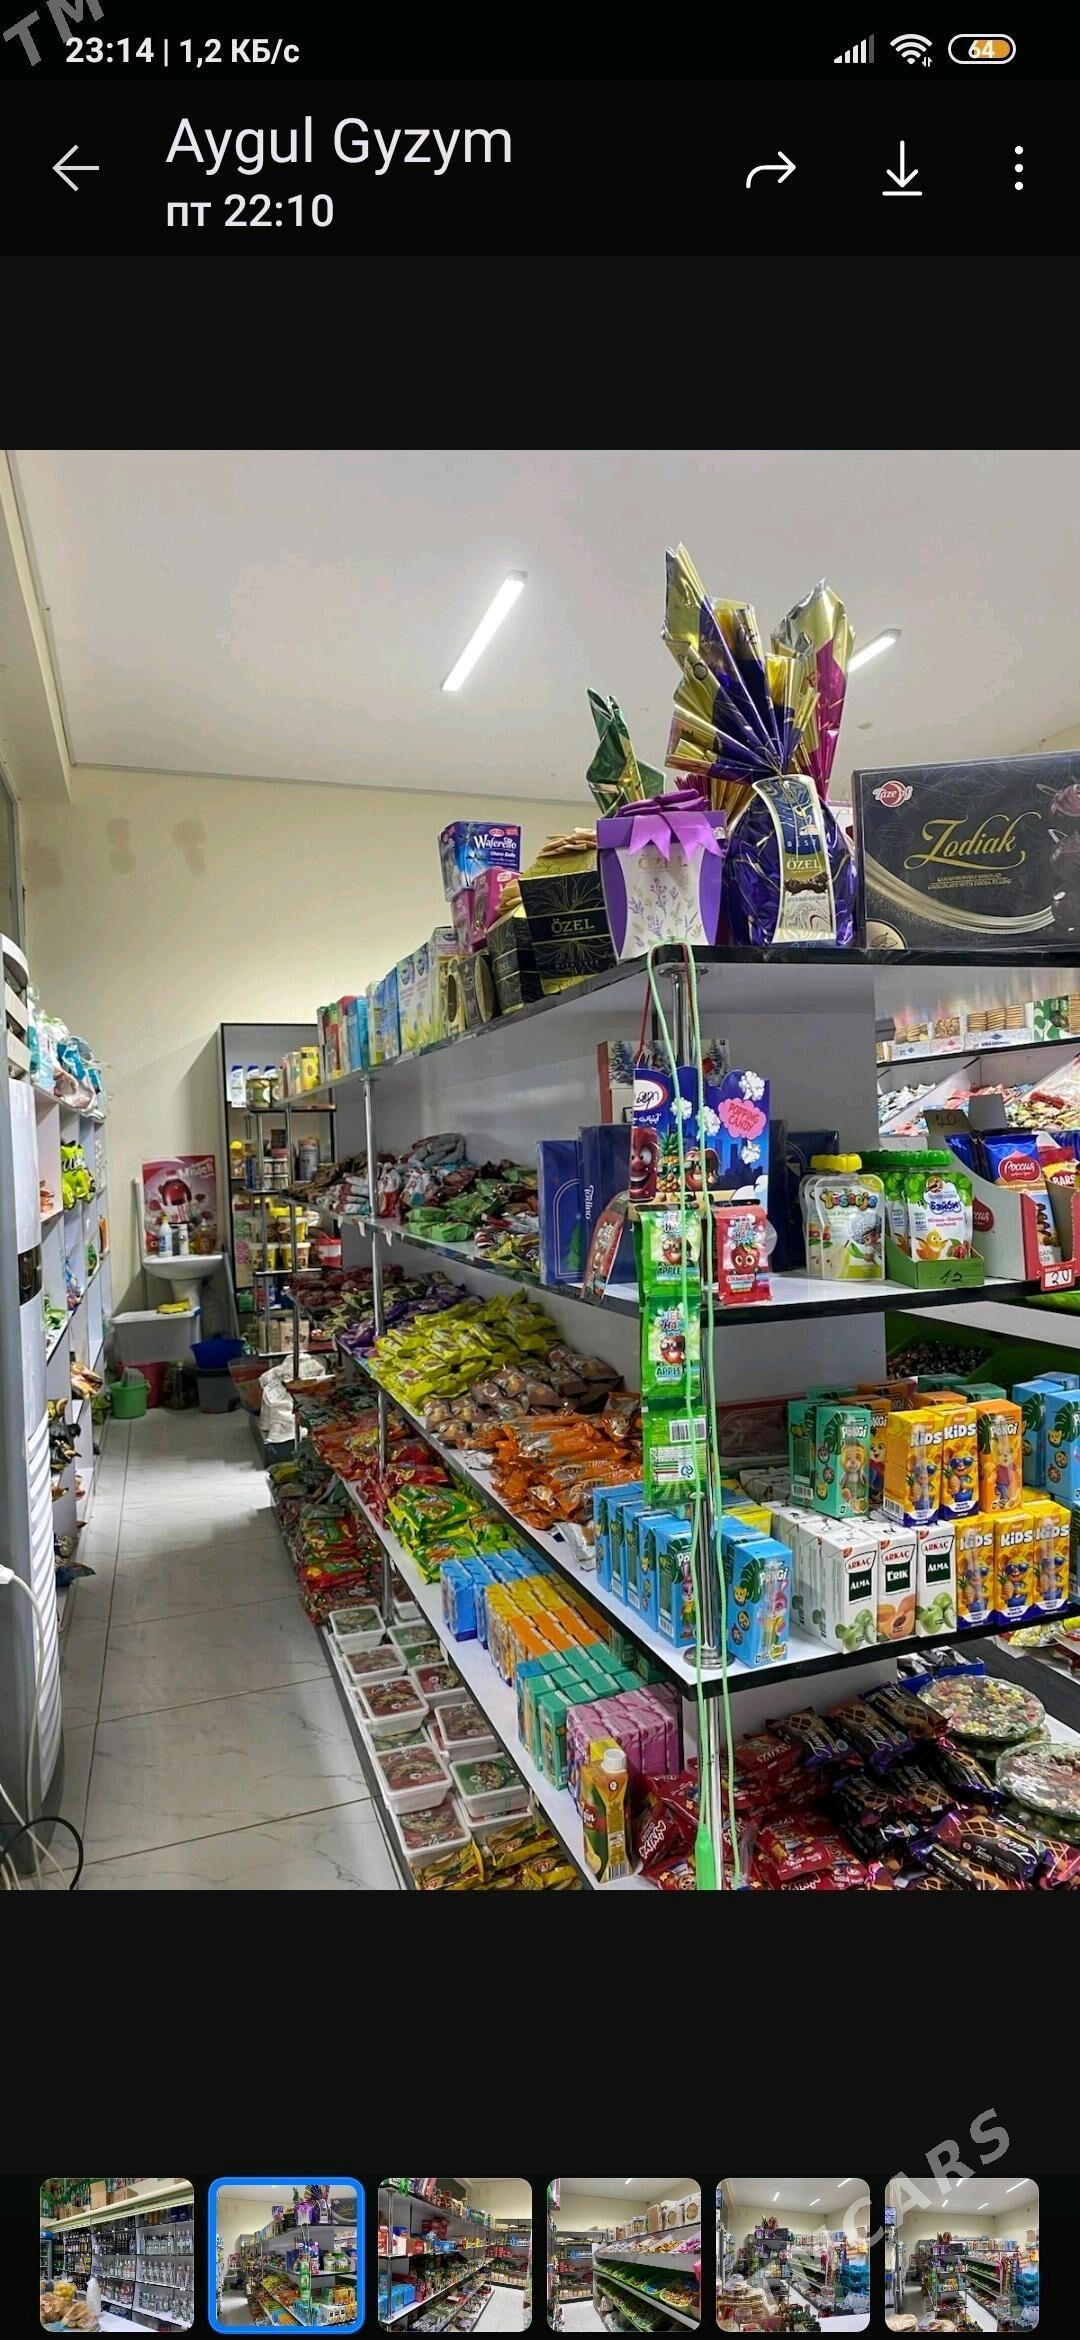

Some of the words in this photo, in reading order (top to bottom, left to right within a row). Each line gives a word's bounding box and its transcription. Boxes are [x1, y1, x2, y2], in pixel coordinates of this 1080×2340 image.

[66, 38, 154, 63] 23:14
[180, 39, 222, 68] 1,2
[231, 39, 299, 64] КБ/с
[968, 40, 995, 58] 64
[165, 116, 312, 175] Aygul
[334, 118, 512, 175] Gyzym
[167, 202, 212, 226] пт
[224, 194, 334, 226] 22:10
[904, 811, 1042, 870] Zodiak
[786, 857, 822, 870] ÖZEL
[550, 918, 595, 934] ÖZEL
[728, 1103, 760, 1123] POPPING
[727, 1115, 754, 1133] CANDY
[1004, 1160, 1036, 1174] Россия
[656, 1366, 682, 1376] APPLE
[943, 1423, 976, 1440] KiDS
[1000, 1528, 1034, 1547] KiDS
[923, 1541, 950, 1553] ARKAÇ
[847, 1557, 871, 1571] ARKAÇ
[883, 1549, 910, 1563] ARKAÇ
[927, 1562, 949, 1573] ALMA
[850, 1578, 870, 1590] ALMA
[886, 1570, 909, 1582] ERIK
